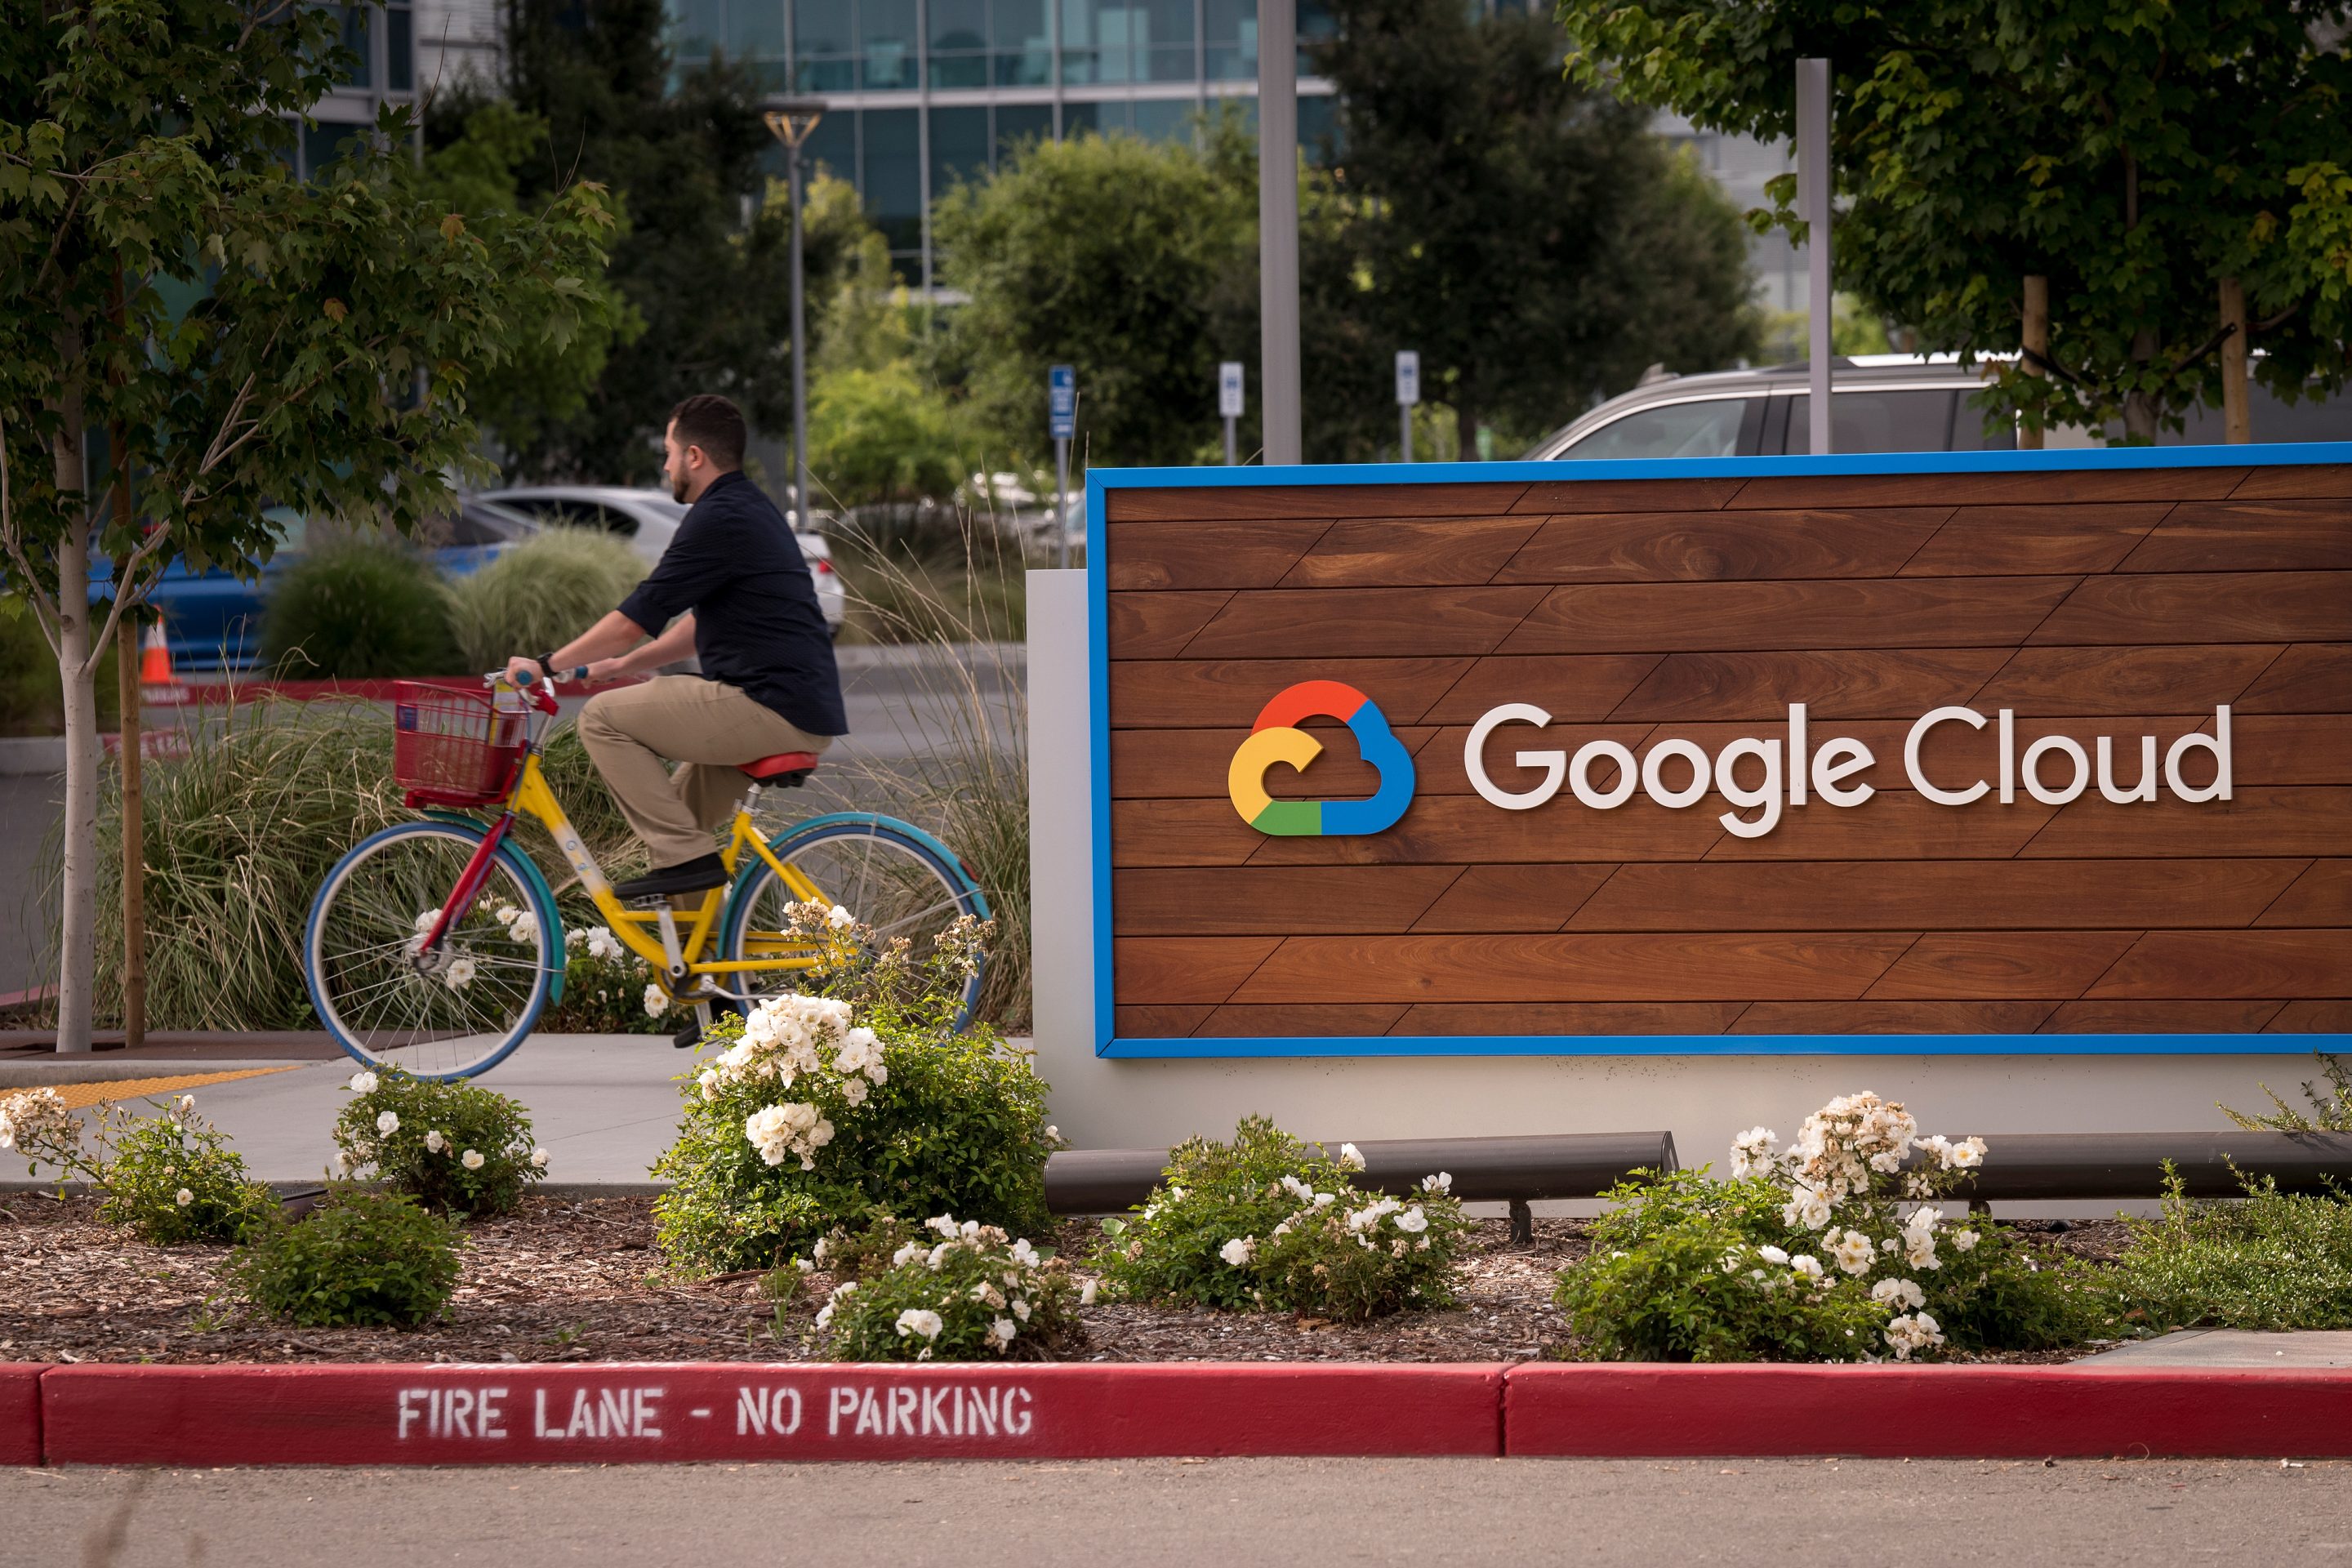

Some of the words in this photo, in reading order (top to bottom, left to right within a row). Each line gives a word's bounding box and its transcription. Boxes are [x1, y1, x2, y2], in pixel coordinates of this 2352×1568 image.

[1463, 702, 1878, 839] Google
[1904, 704, 2234, 806] Cloud
[399, 1388, 508, 1438] FIRE
[534, 1388, 664, 1437] LANE
[690, 1409, 710, 1417] -
[737, 1387, 801, 1436] NO
[828, 1387, 1031, 1436] PARKING
